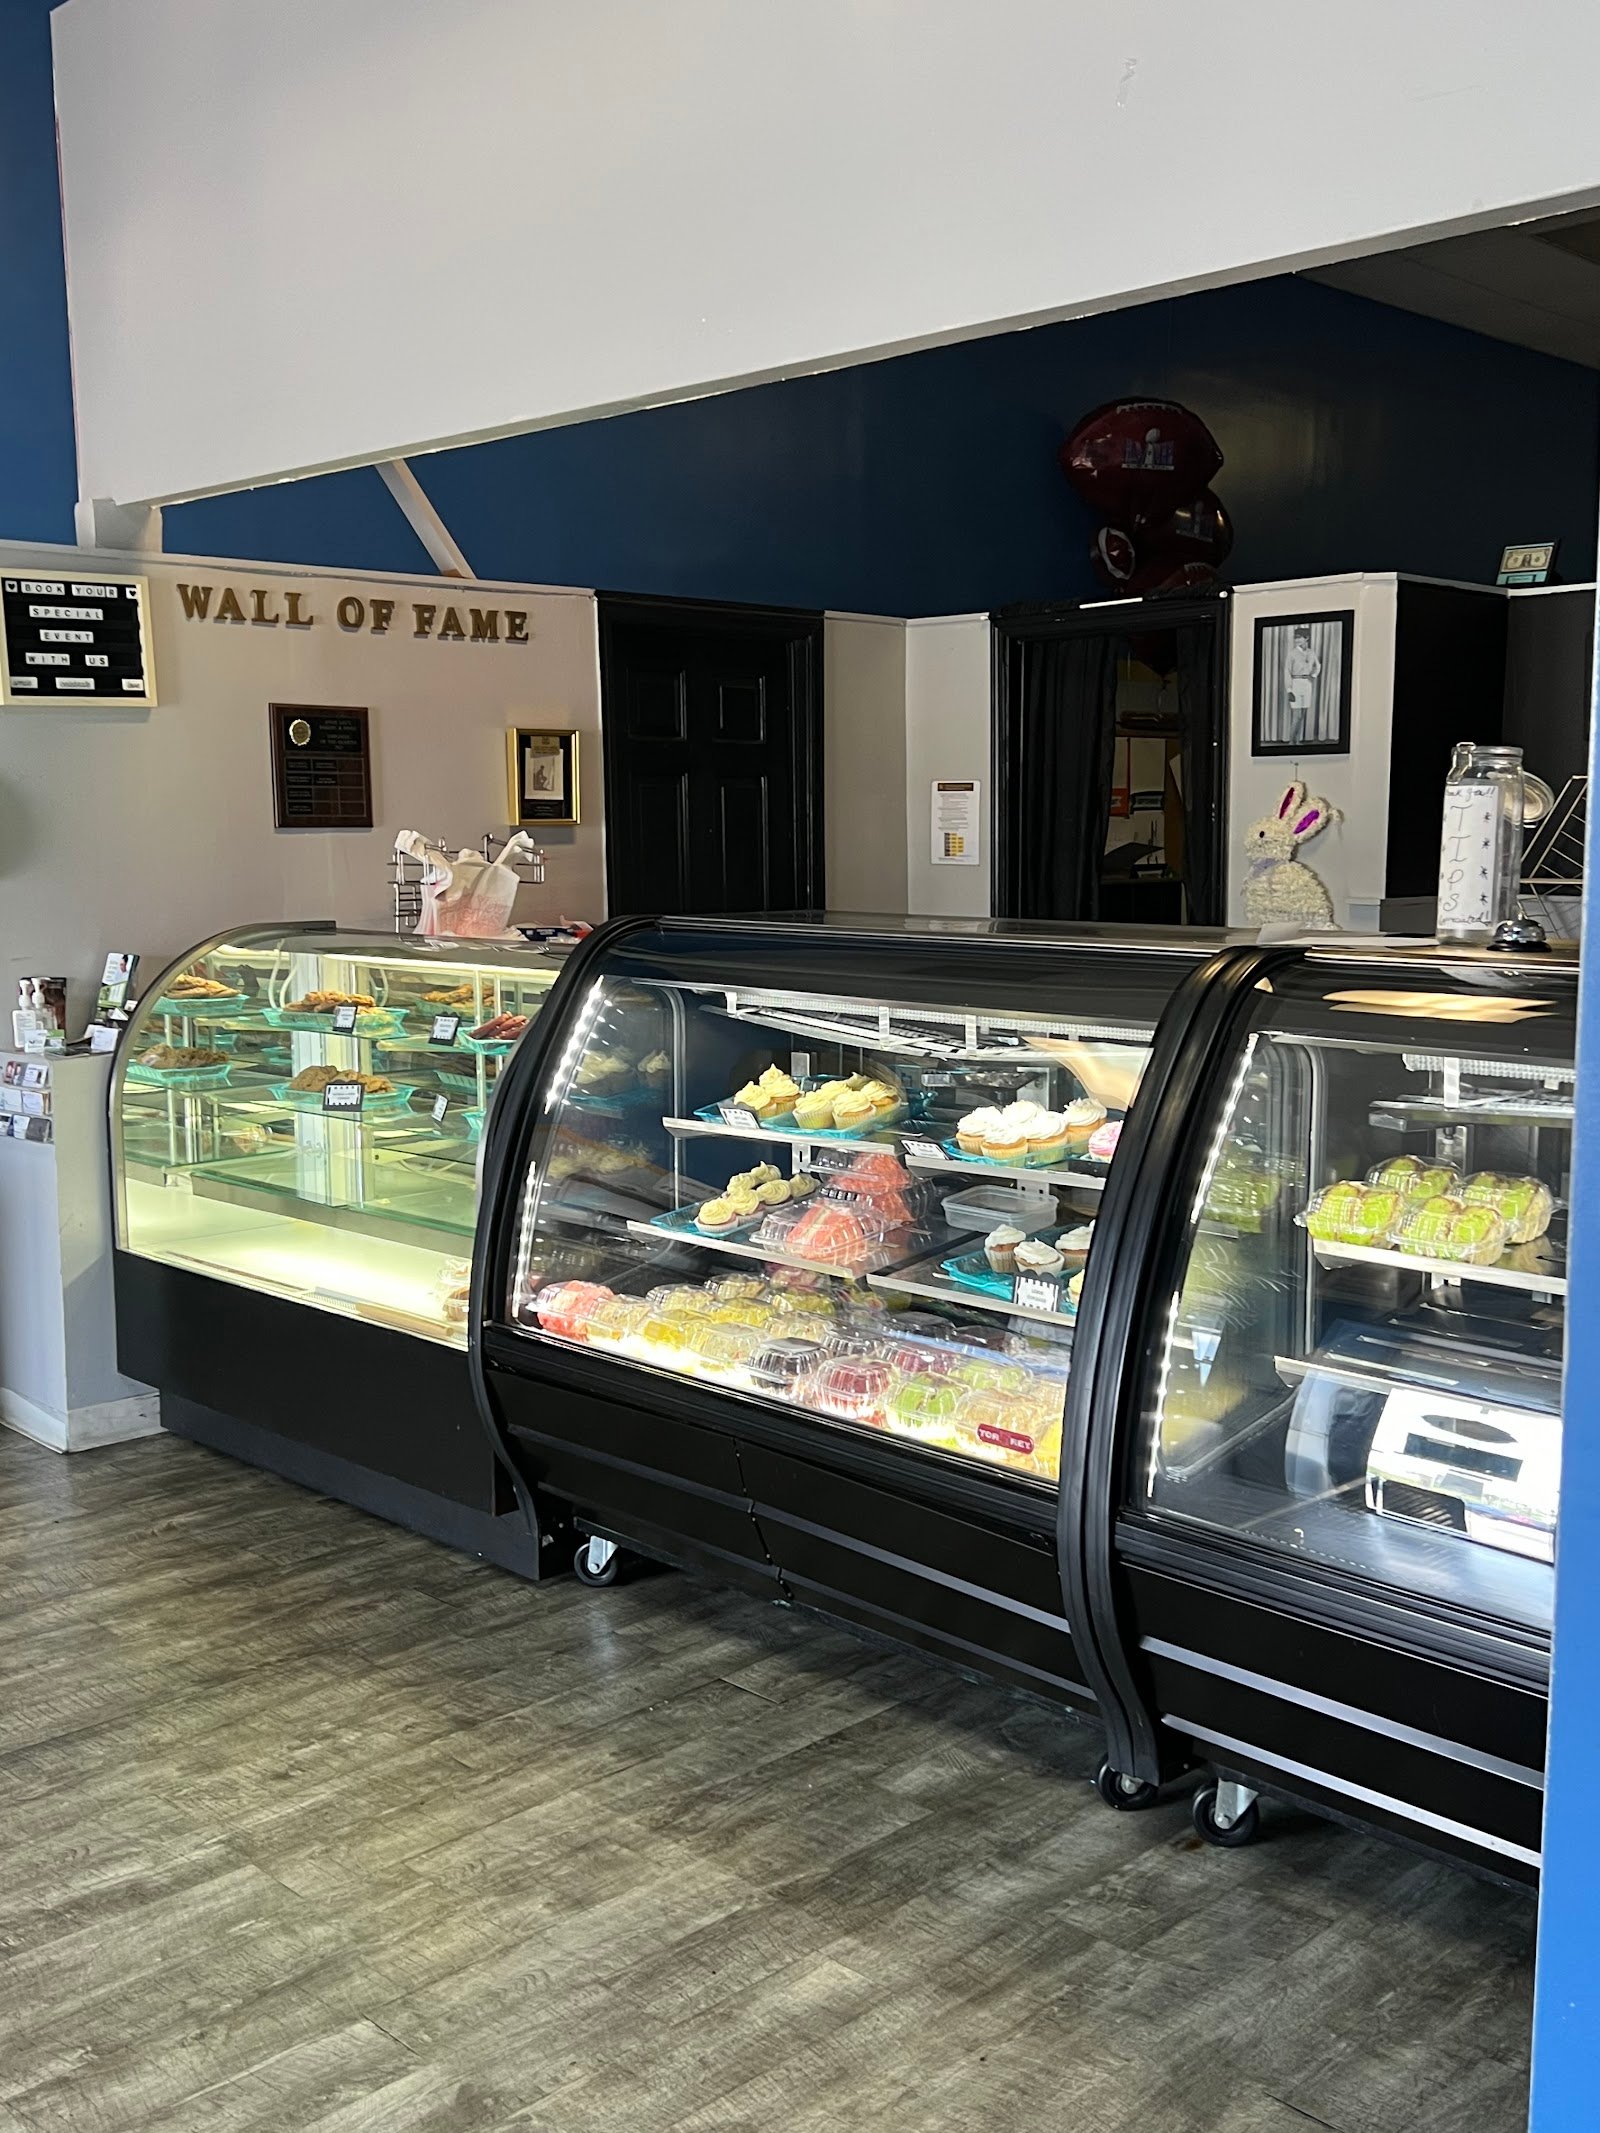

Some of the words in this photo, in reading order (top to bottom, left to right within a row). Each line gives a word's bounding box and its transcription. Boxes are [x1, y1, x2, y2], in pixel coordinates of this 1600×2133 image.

[24, 583, 63, 594] BOOK
[75, 586, 115, 597] YOUR
[32, 607, 102, 619] SPECIAL
[177, 584, 314, 626] WALL
[336, 596, 395, 632] OF
[412, 604, 529, 642] FAME
[43, 631, 92, 641] EVENT
[28, 654, 69, 664] WITH
[88, 656, 106, 666] US
[1443, 804, 1473, 912] TIPS
